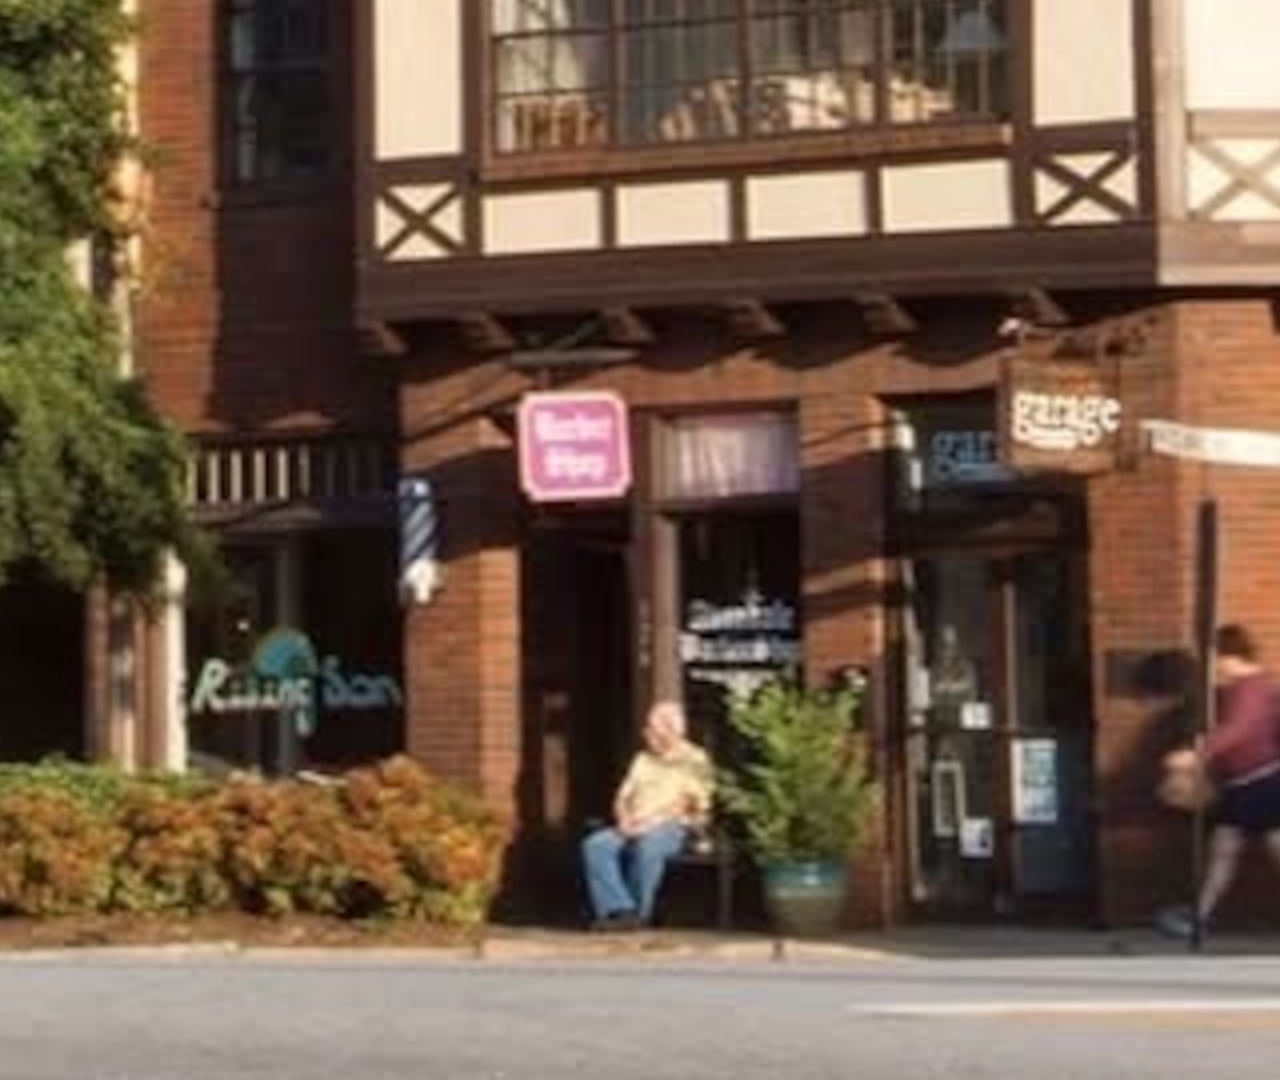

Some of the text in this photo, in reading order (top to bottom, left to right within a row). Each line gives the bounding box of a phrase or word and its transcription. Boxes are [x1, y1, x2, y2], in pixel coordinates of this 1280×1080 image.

[1011, 391, 1121, 451] garage
[932, 430, 1001, 482] gar
[190, 657, 314, 738] Rising
